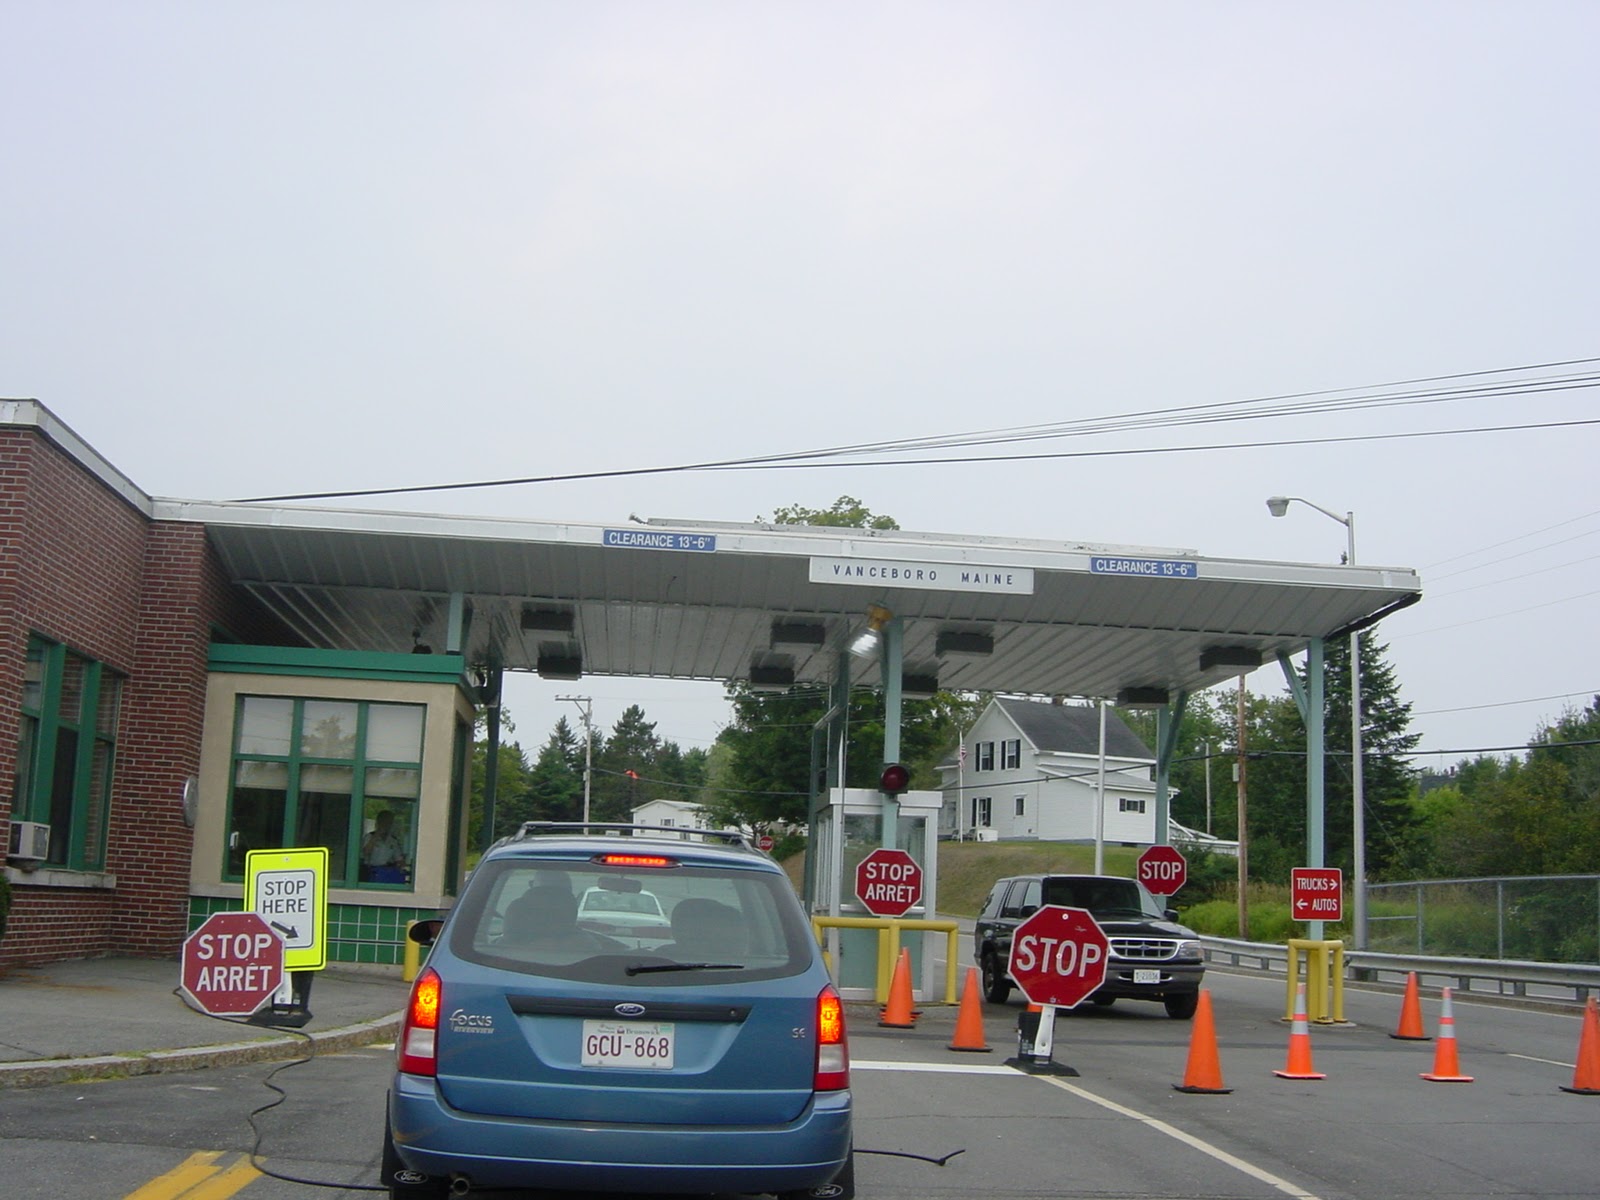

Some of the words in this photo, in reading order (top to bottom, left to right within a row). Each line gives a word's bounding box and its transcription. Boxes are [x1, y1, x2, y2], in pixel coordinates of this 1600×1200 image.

[609, 531, 673, 547] CLEARANCE
[833, 564, 937, 581] VANCEBORO
[961, 572, 1013, 585] MAINE
[1096, 559, 1158, 574] CLEARANCE
[866, 861, 915, 881] STOP
[1142, 861, 1182, 880] STOP
[264, 880, 307, 896] STOP
[865, 882, 915, 903] ARRÊT
[1296, 877, 1328, 891] TRUCKS
[262, 898, 308, 914] HERE
[1312, 898, 1338, 911] AUTOS
[197, 933, 272, 960] STOP
[1016, 935, 1101, 978] STOP
[196, 963, 273, 992] ARRÊT
[792, 1027, 806, 1038] SE
[586, 1035, 669, 1058] GCU-868
